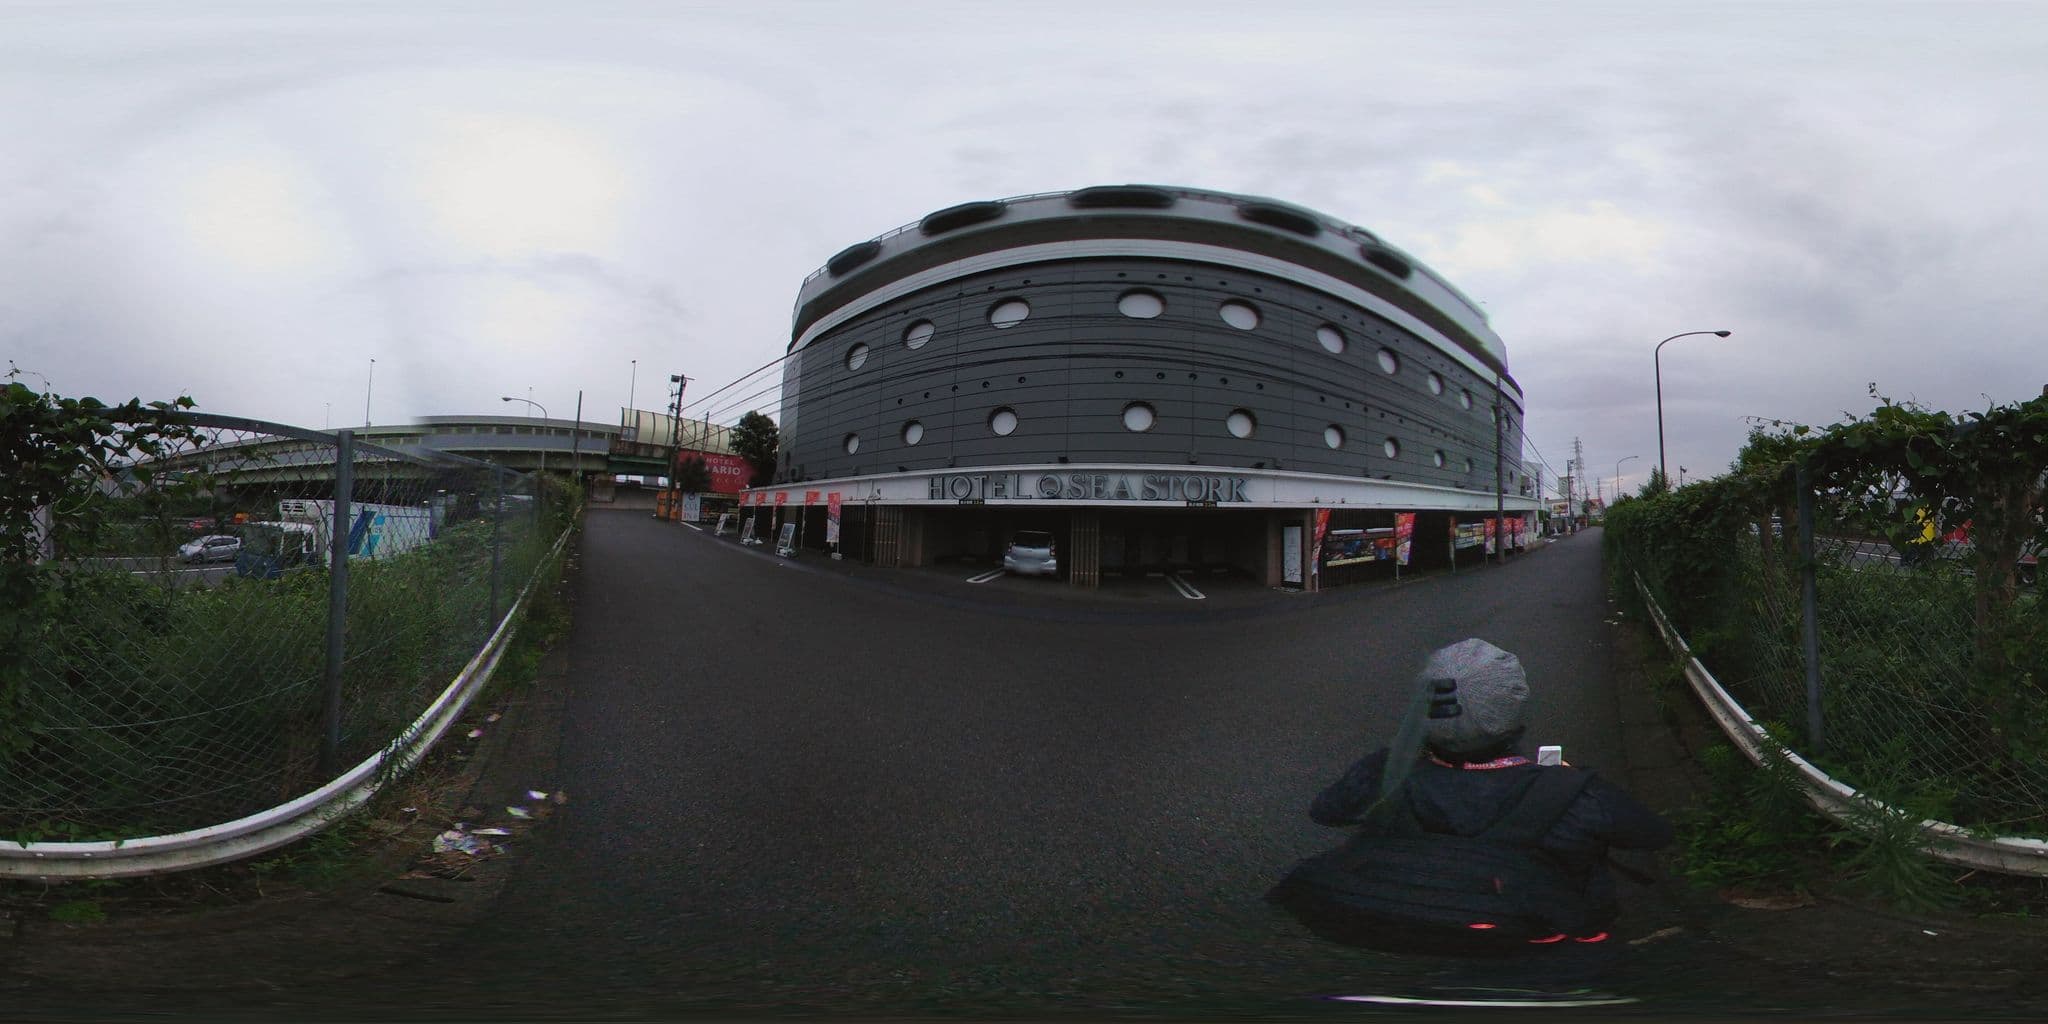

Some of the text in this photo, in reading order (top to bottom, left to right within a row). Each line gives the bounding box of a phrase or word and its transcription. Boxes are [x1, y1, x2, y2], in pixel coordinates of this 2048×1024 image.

[705, 457, 735, 466] HOTEL
[928, 473, 1032, 500] HOTEL
[1141, 473, 1252, 503] STORK
